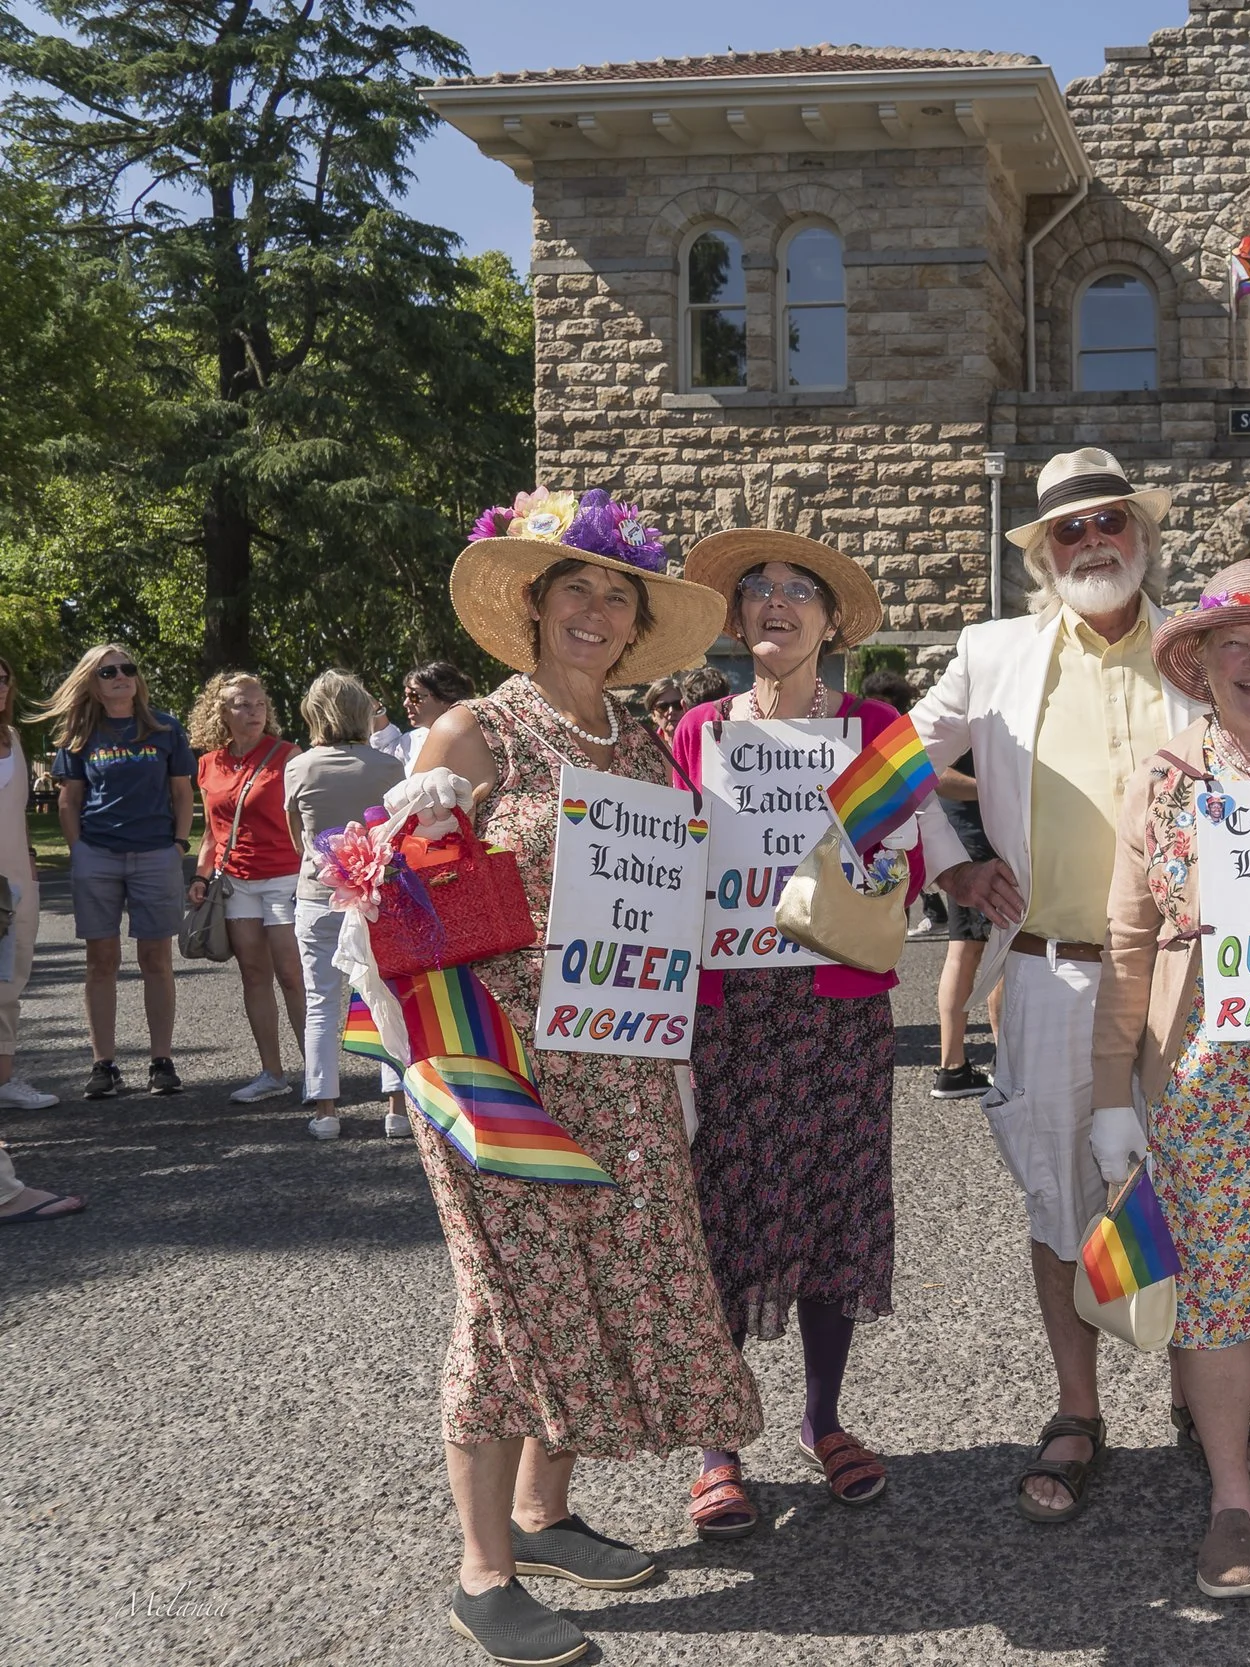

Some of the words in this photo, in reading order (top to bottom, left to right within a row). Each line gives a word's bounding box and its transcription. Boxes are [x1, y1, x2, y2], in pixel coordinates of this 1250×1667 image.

[730, 741, 835, 776] Church
[589, 797, 688, 849] Church
[762, 828, 805, 857] for
[589, 844, 683, 891] Ladies
[611, 899, 654, 934] for
[562, 939, 691, 993] QUEER
[547, 1005, 689, 1046] RIGHTS
